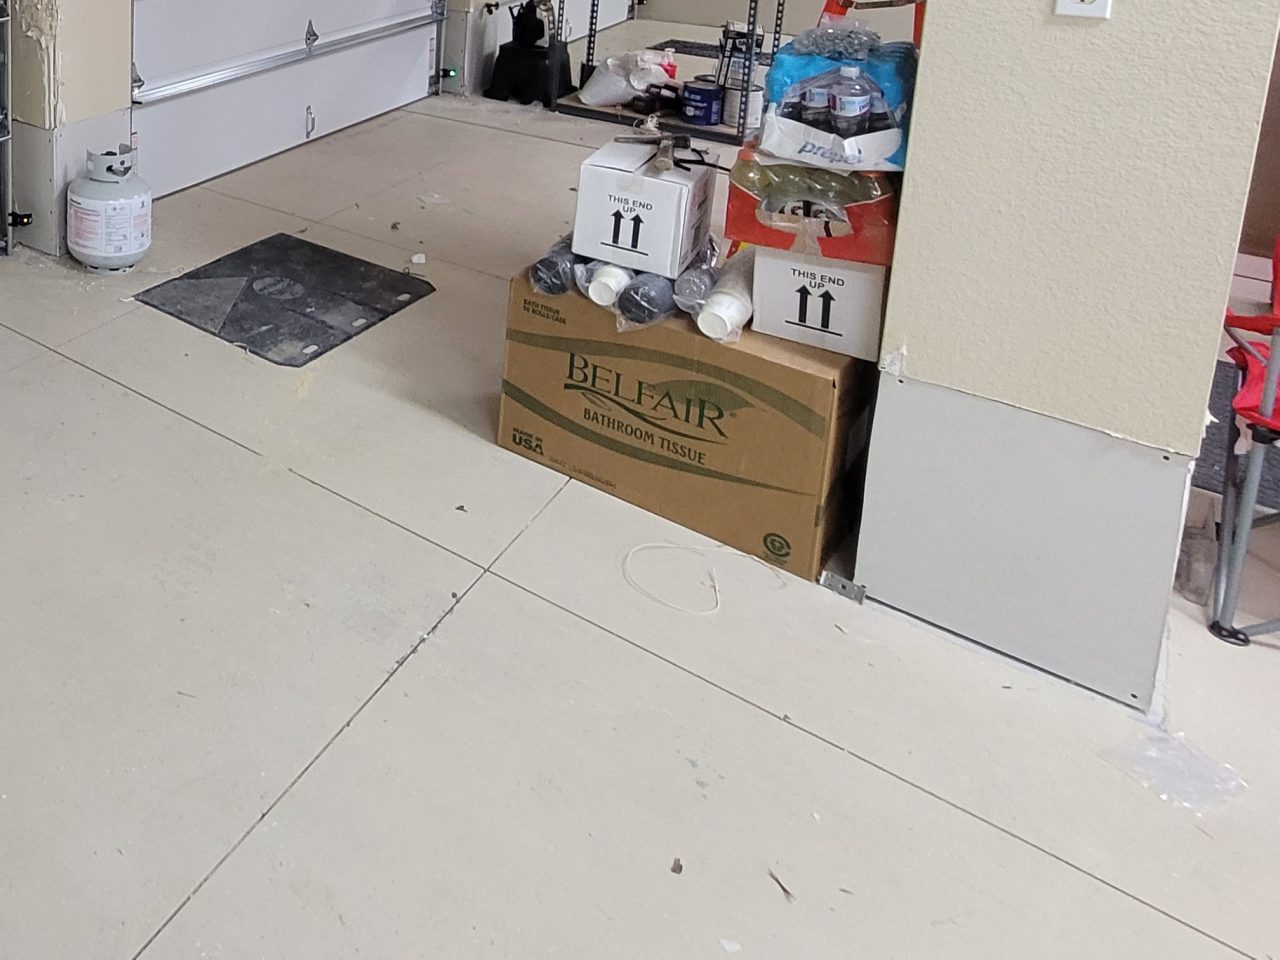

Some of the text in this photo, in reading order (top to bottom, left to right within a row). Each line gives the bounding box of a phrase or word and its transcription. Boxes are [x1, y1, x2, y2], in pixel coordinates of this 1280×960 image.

[608, 194, 653, 211] THIS END
[622, 205, 637, 214] UP
[791, 268, 845, 287] THIS END
[809, 281, 825, 290] UP
[523, 298, 561, 315] BATH TISSUE
[566, 352, 729, 439] BELFAIR
[513, 427, 533, 439] MADE
[583, 407, 707, 466] BATHROOM TISSUE
[512, 433, 545, 456] USA
